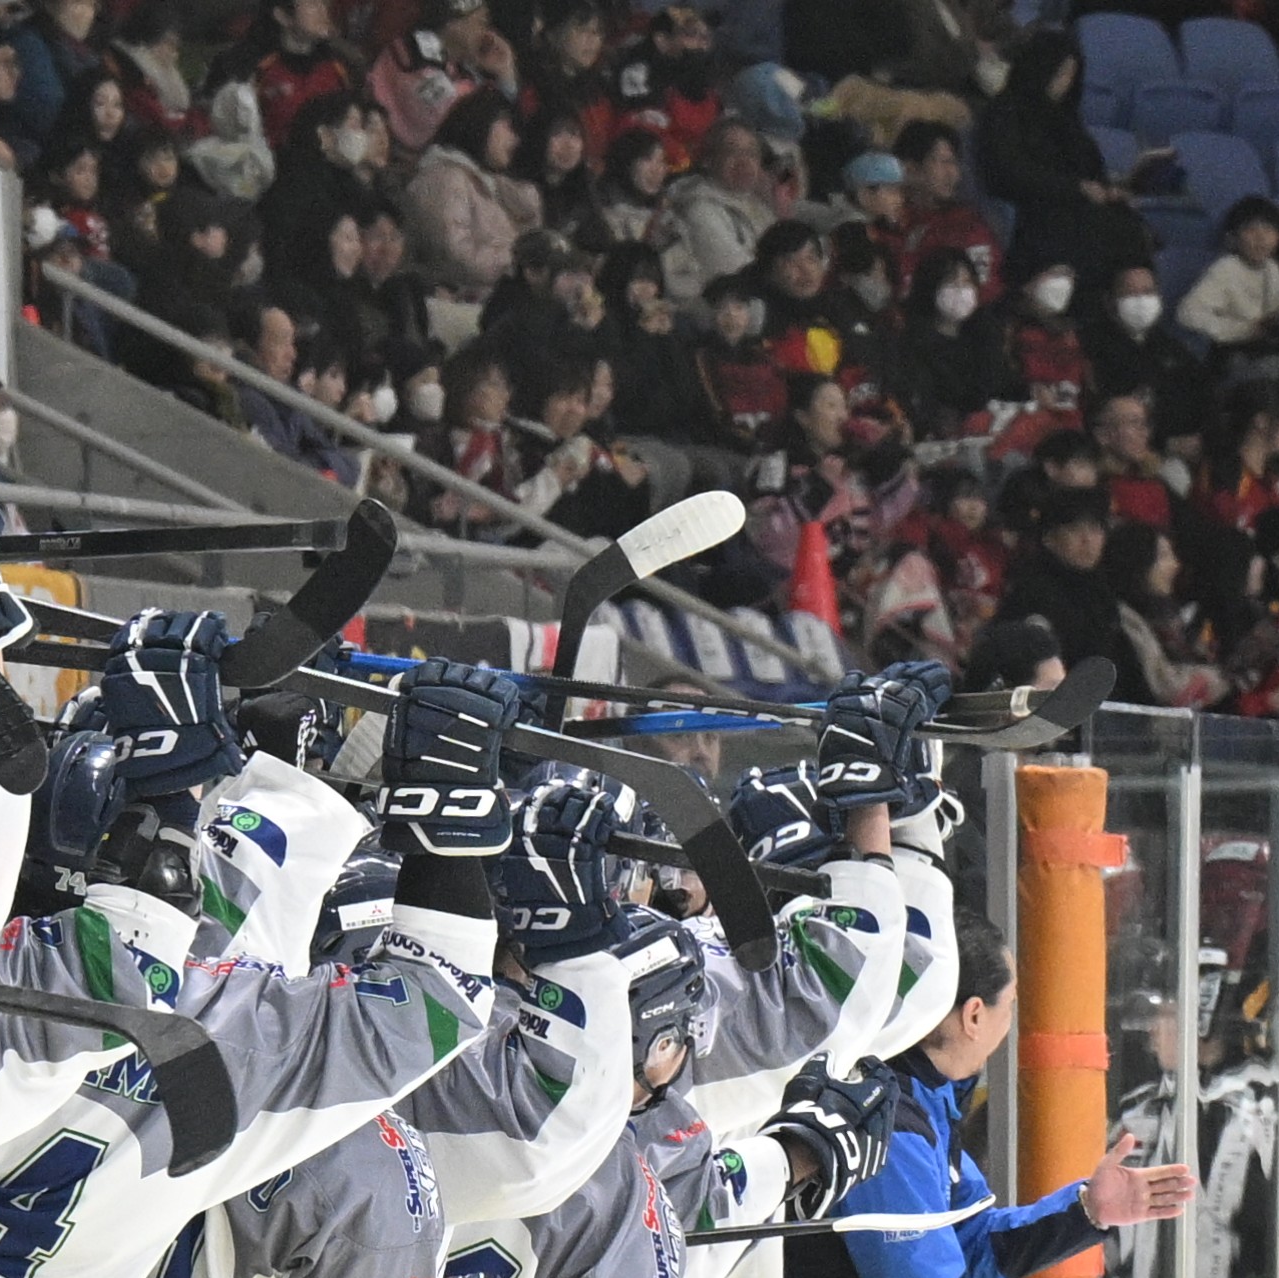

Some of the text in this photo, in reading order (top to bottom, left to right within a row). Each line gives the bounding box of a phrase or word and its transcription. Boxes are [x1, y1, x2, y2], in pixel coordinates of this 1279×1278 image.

[54, 866, 87, 896] 74
[640, 1000, 676, 1020] CCM
[398, 1149, 424, 1217] SUPER
